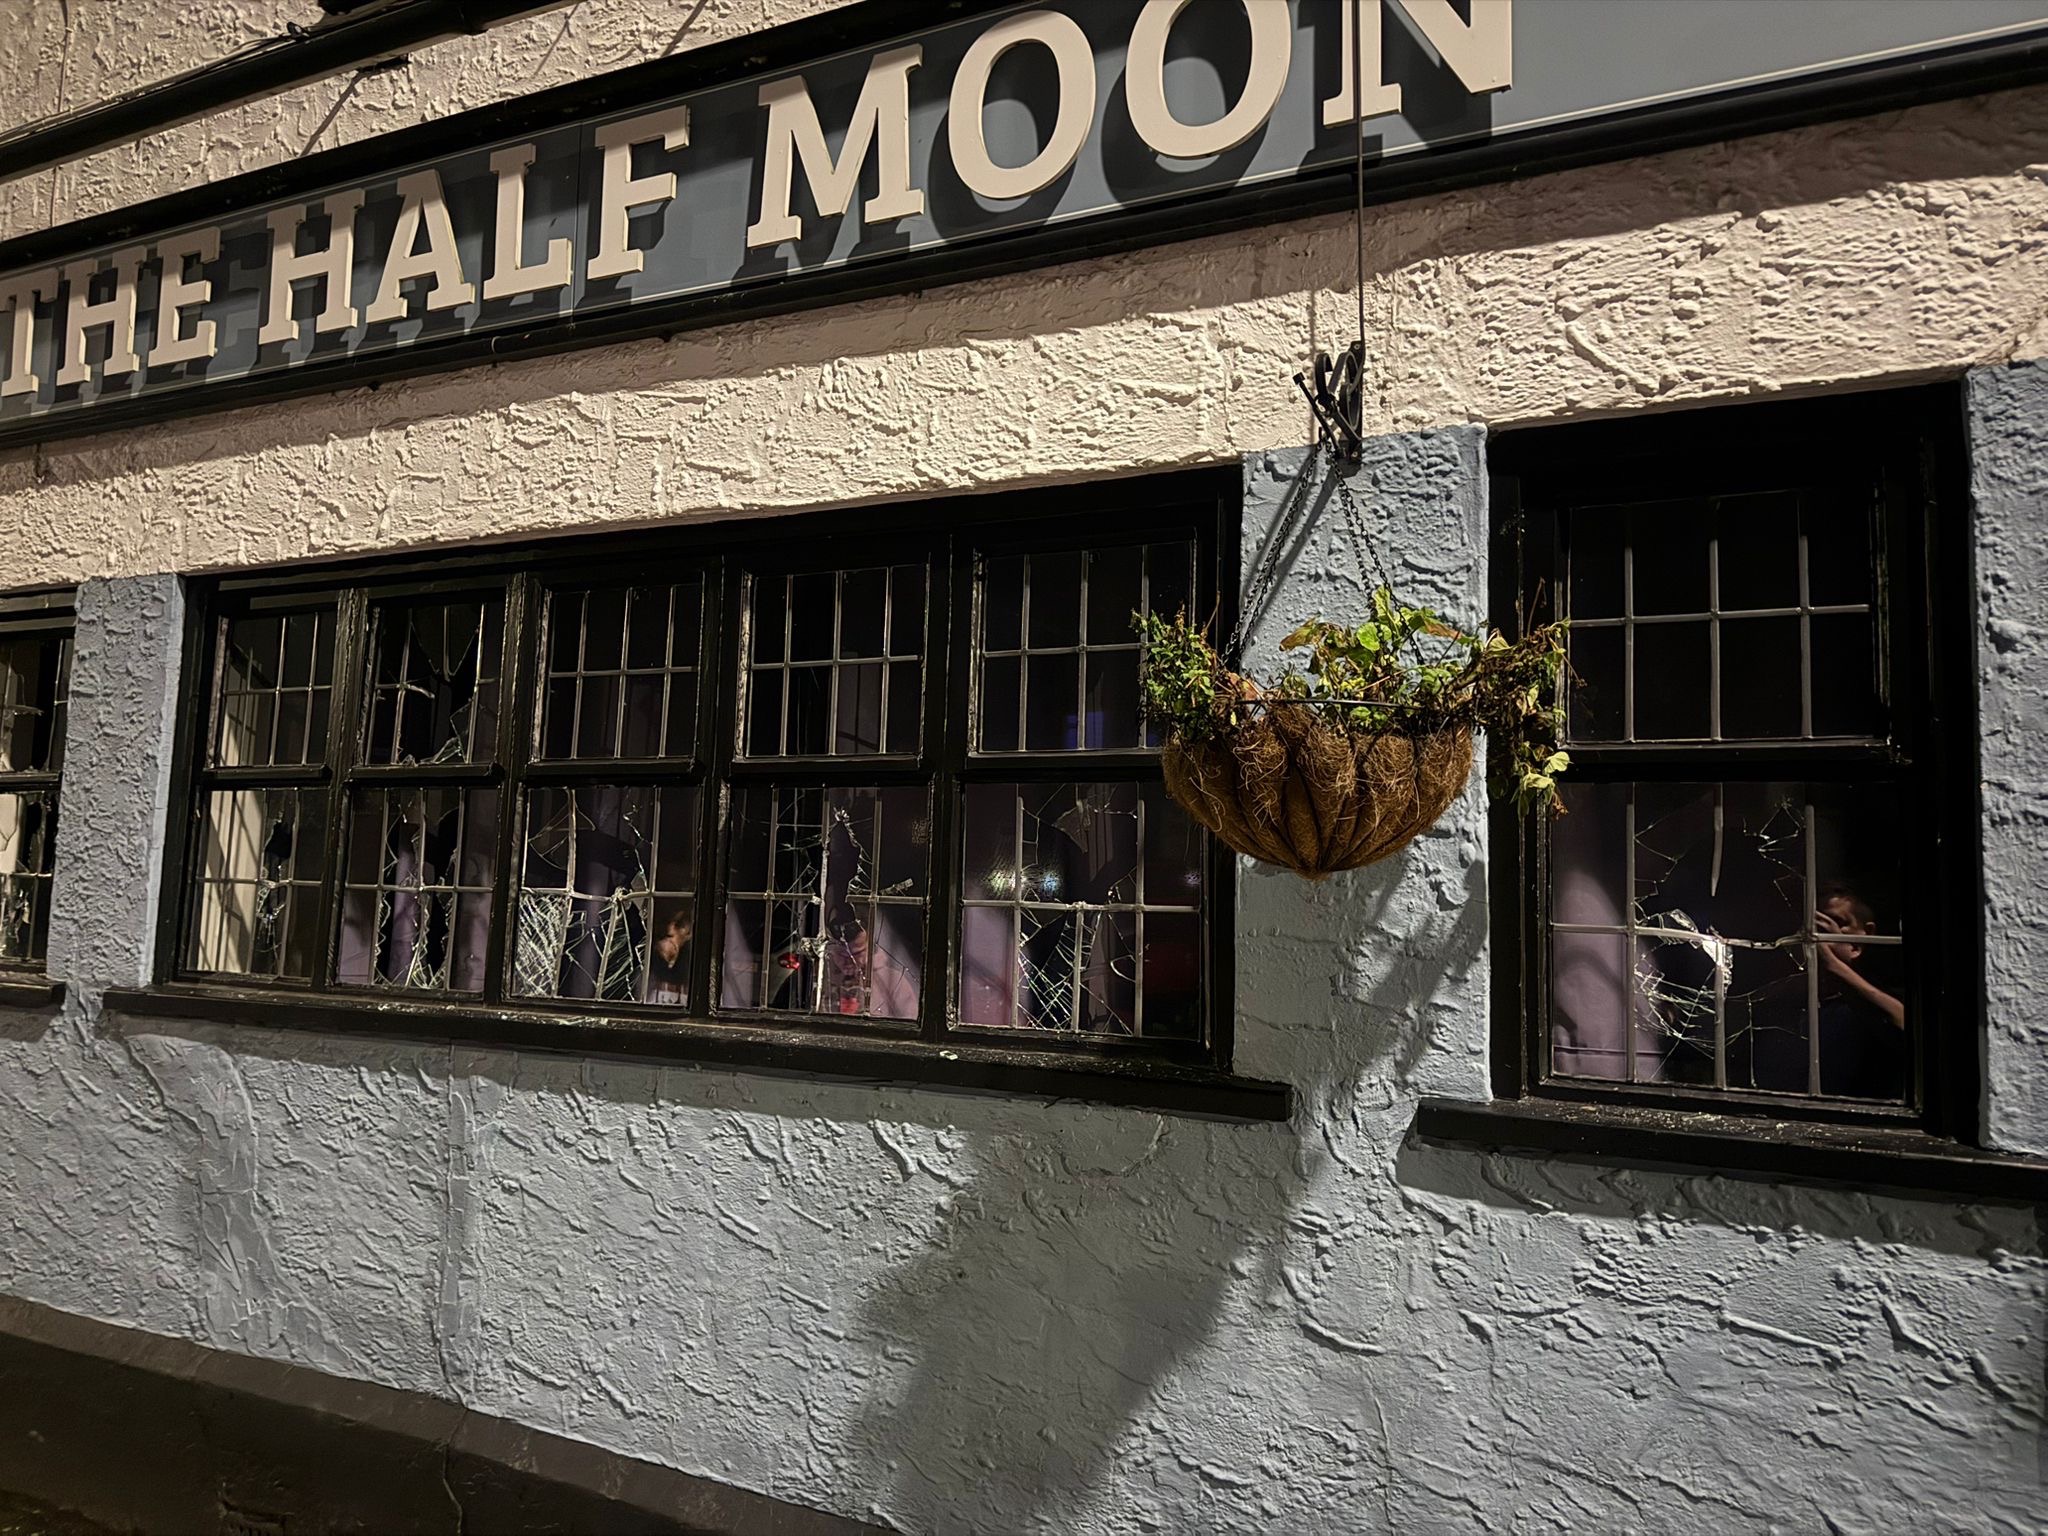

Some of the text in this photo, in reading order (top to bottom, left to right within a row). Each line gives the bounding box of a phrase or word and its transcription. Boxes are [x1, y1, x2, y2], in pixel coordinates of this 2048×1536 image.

[0, 0, 1512, 397] THE HALF MOON
